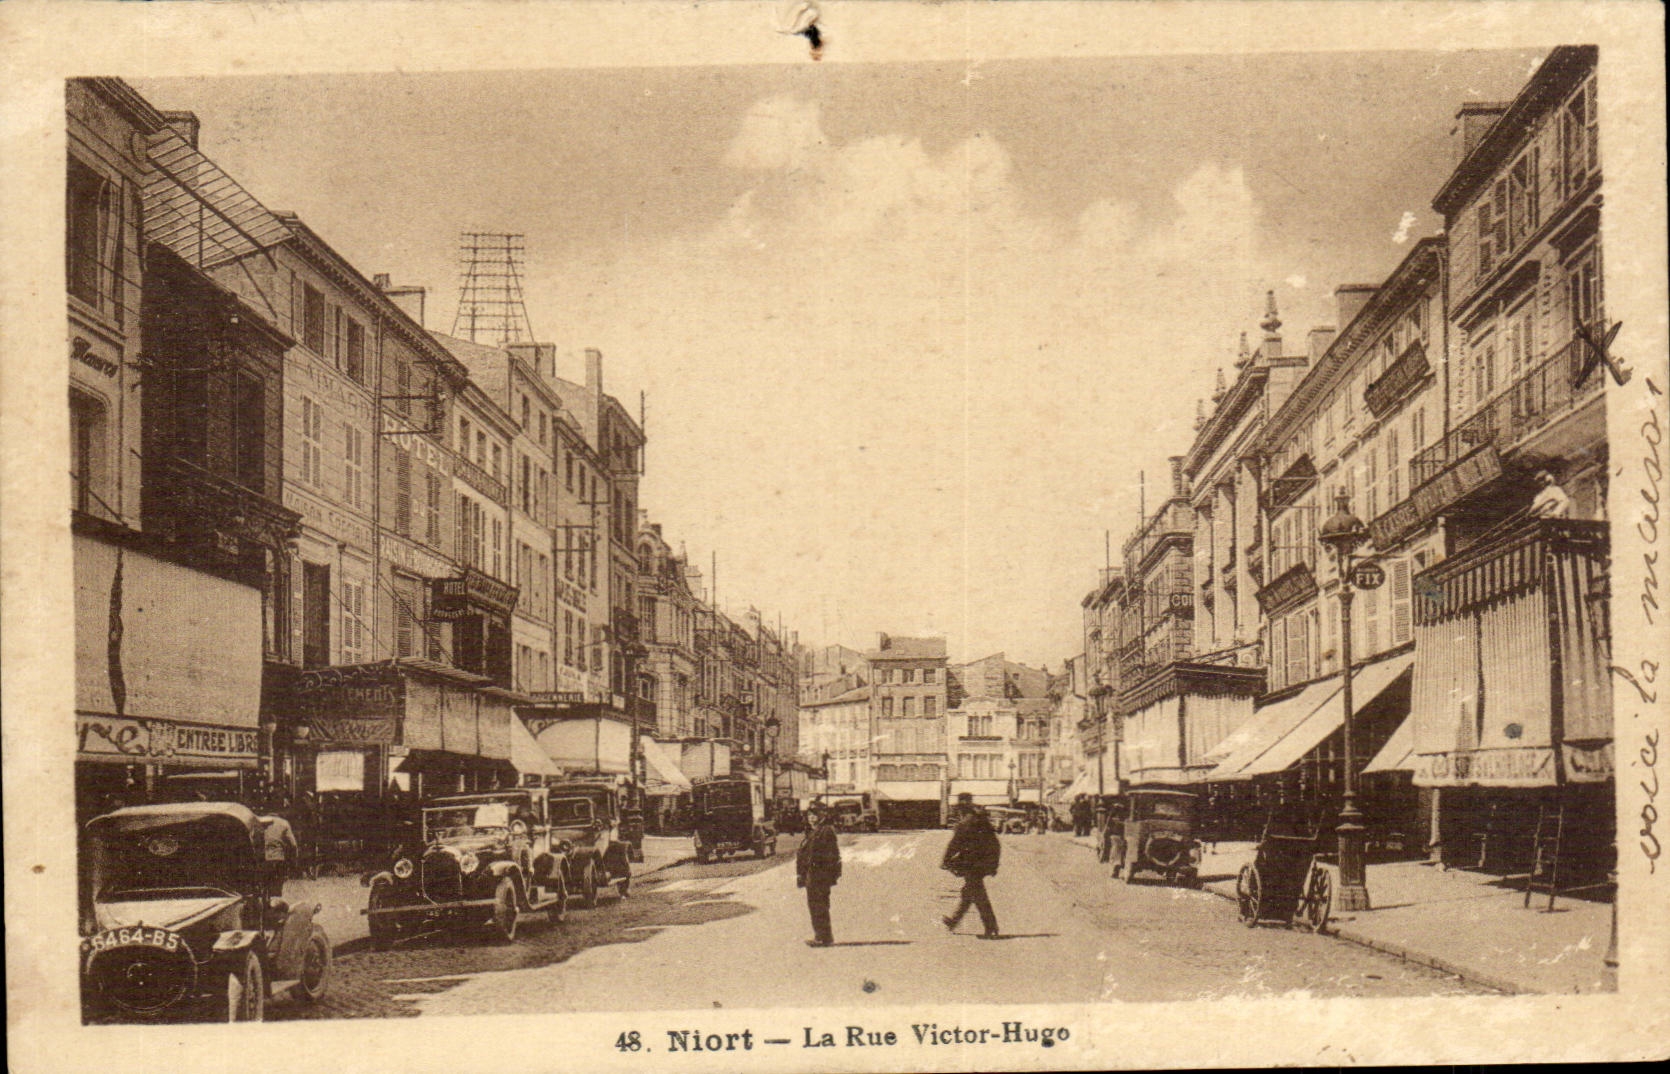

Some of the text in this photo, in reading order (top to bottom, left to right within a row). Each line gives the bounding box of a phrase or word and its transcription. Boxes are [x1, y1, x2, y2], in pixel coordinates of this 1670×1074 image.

[383, 412, 448, 477] HOTEL
[1356, 574, 1380, 585] FIX
[1613, 659, 1659, 704] la
[177, 728, 226, 752] ENTREE
